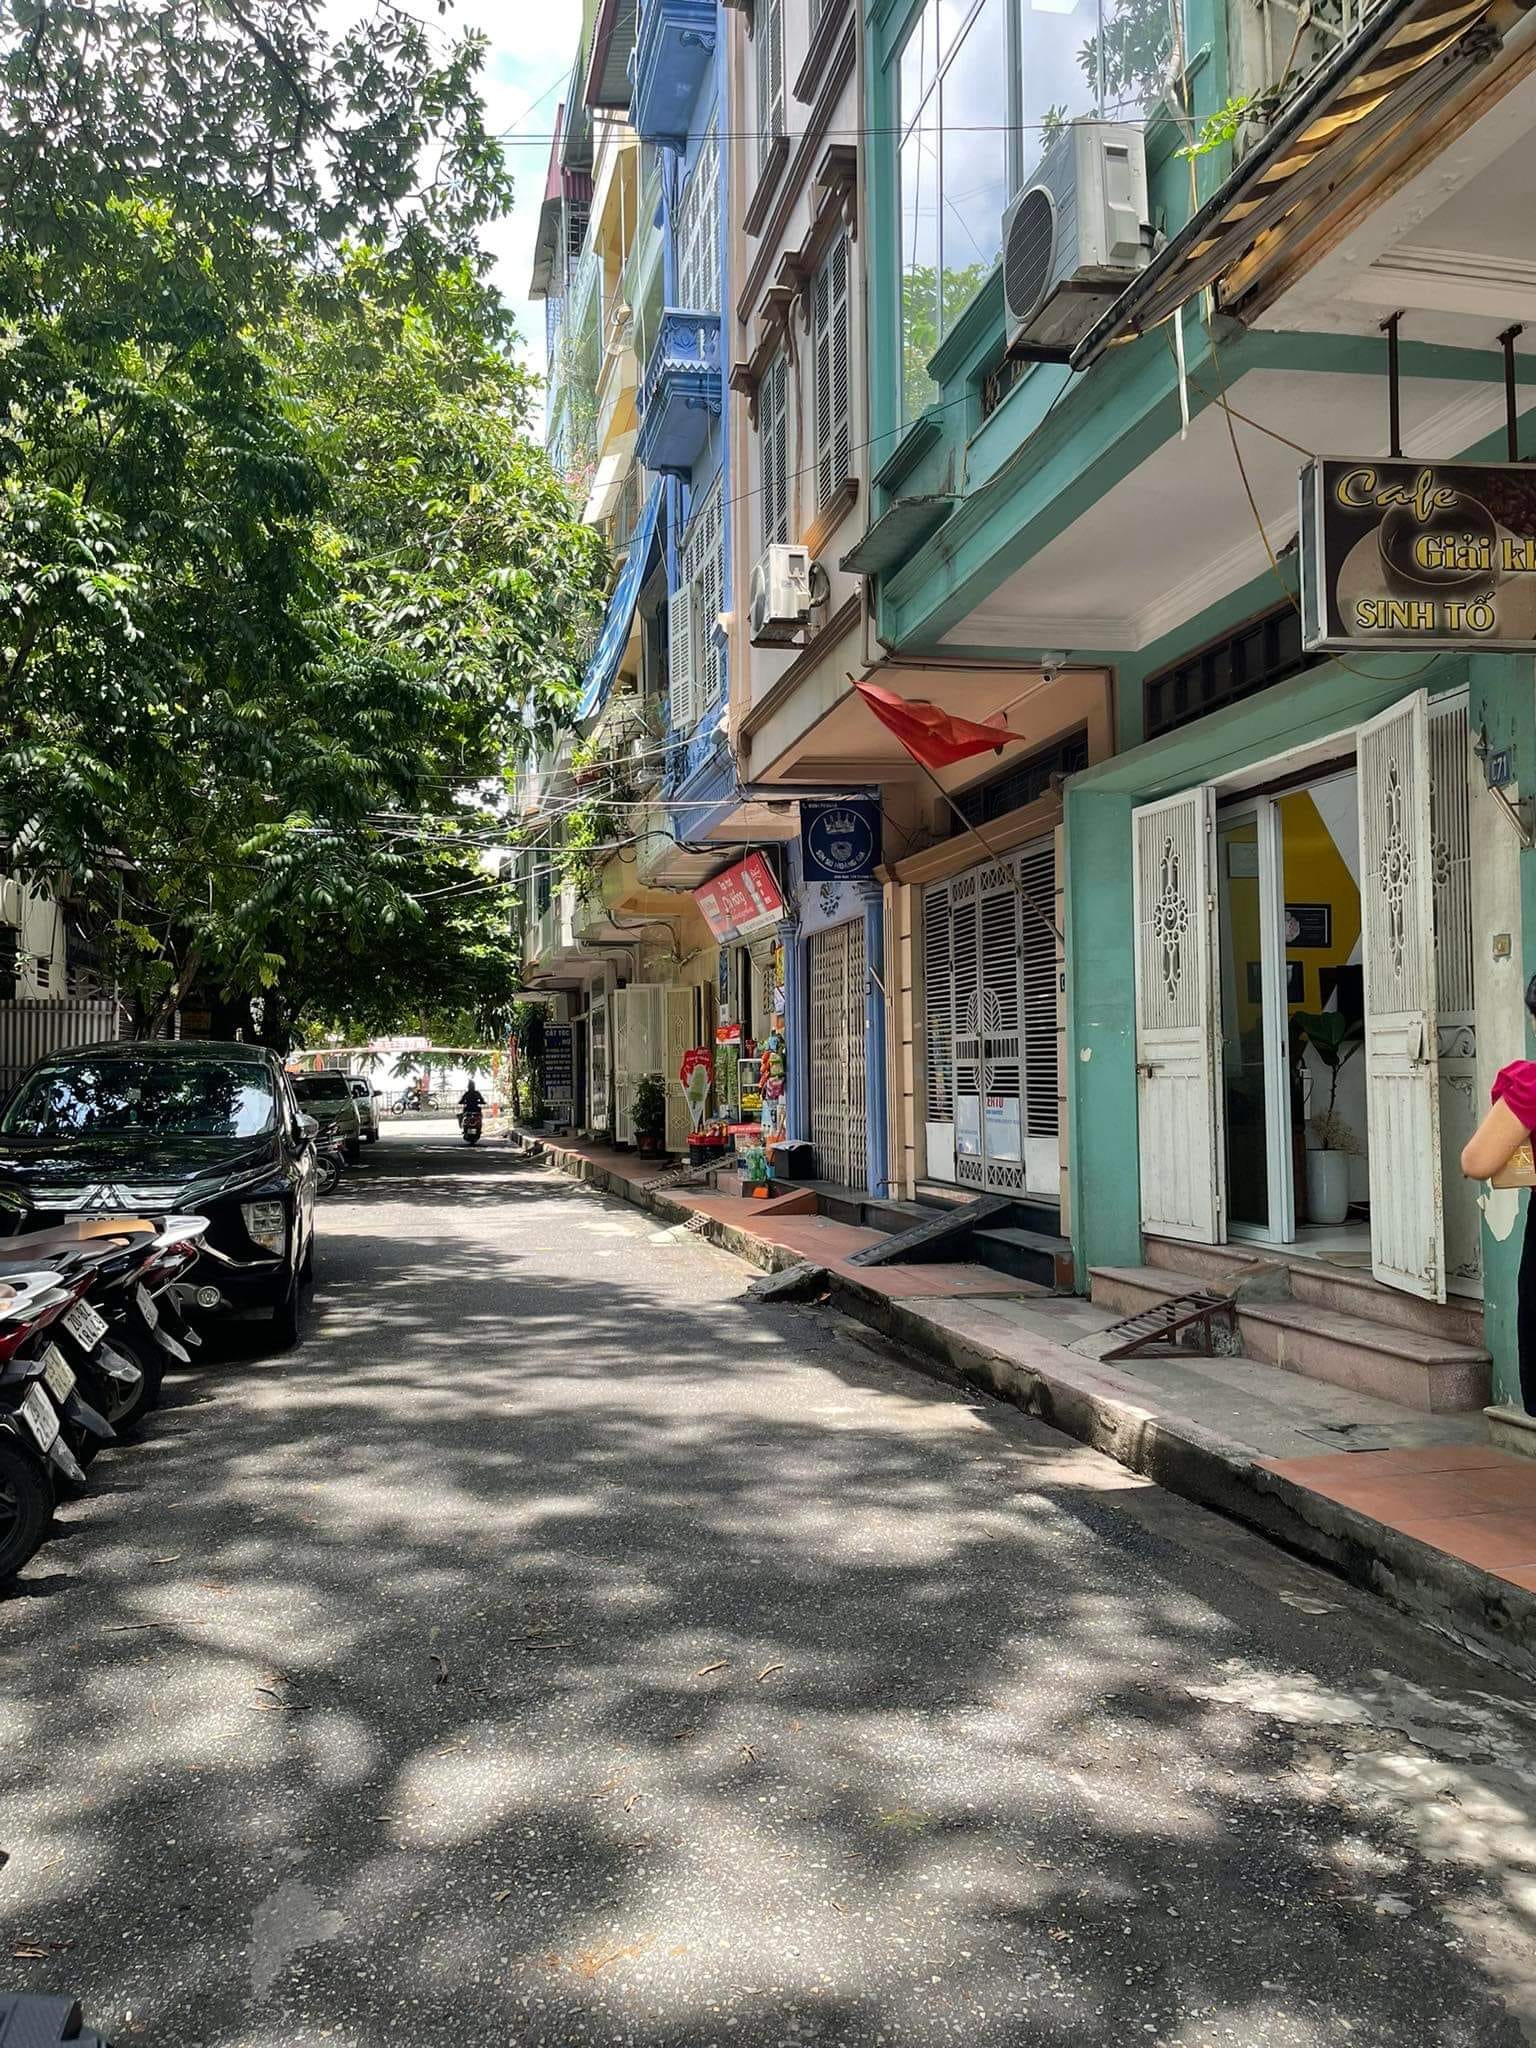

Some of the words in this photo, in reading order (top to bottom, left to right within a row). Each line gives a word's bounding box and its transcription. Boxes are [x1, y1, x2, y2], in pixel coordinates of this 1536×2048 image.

[1337, 468, 1458, 522] Cafe
[1415, 534, 1492, 572] Giải
[1356, 599, 1434, 631] SINH
[1443, 591, 1496, 632] TỐ
